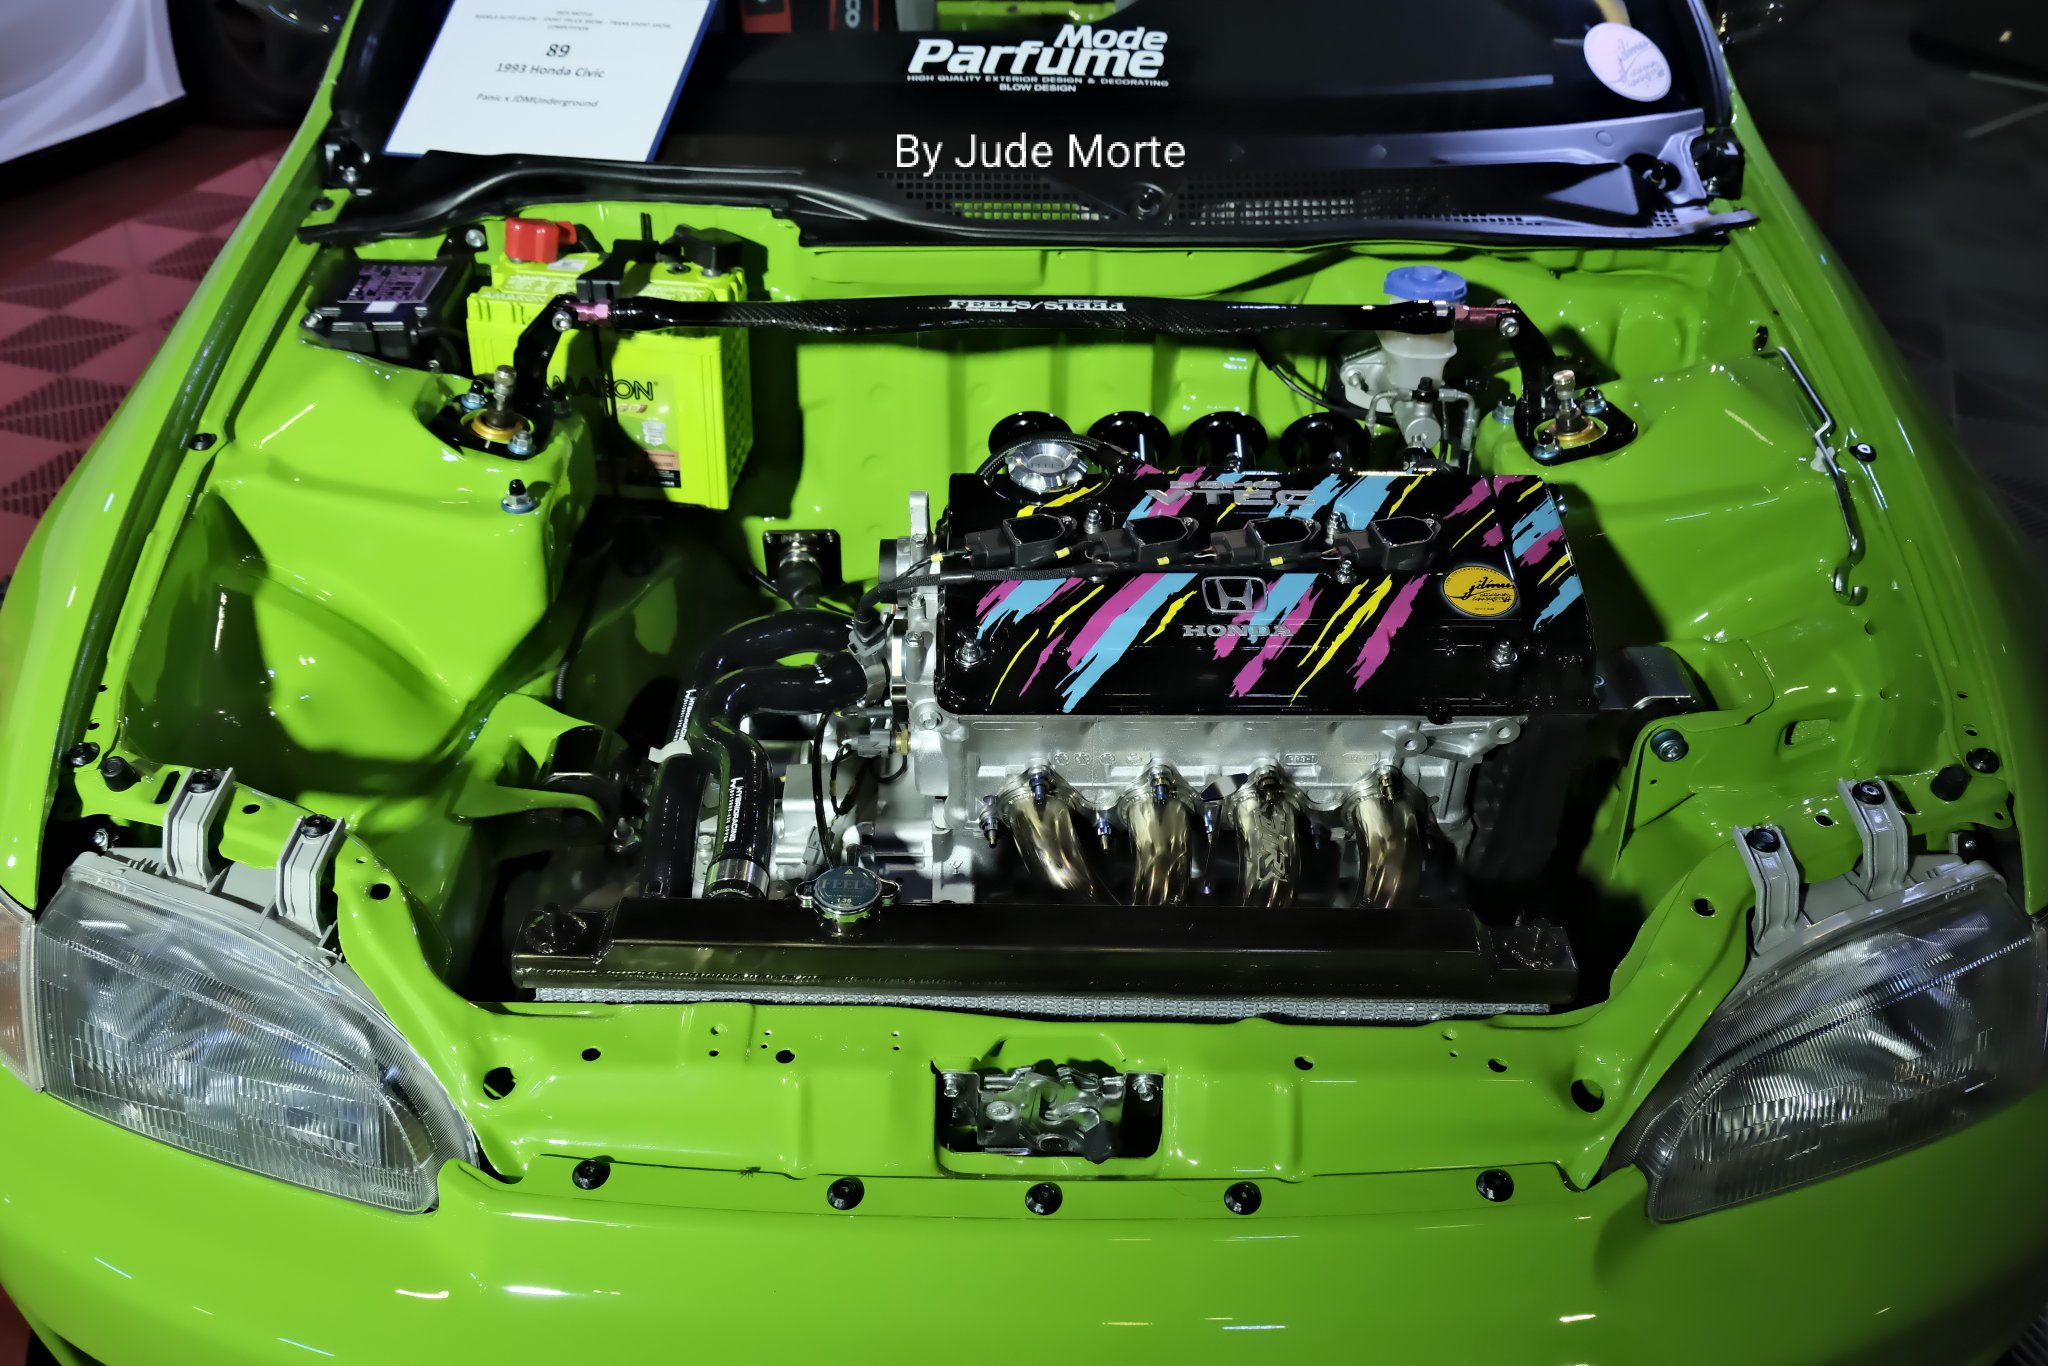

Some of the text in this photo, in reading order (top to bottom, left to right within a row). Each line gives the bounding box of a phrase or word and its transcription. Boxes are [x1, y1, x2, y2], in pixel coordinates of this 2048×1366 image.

[1053, 24, 1169, 51] Mode
[545, 43, 570, 58] 89
[907, 38, 1165, 79] Parfume
[495, 62, 605, 78] 1993 Honda Civic
[938, 75, 982, 83] QUALITY
[985, 75, 1038, 83] EXTERIOR
[1087, 77, 1096, 85] &
[1101, 78, 1169, 87] DECORATING
[999, 83, 1077, 92] BLOW DESIGN
[1145, 489, 1316, 506] VTEC
[1182, 624, 1295, 637] HONDA
